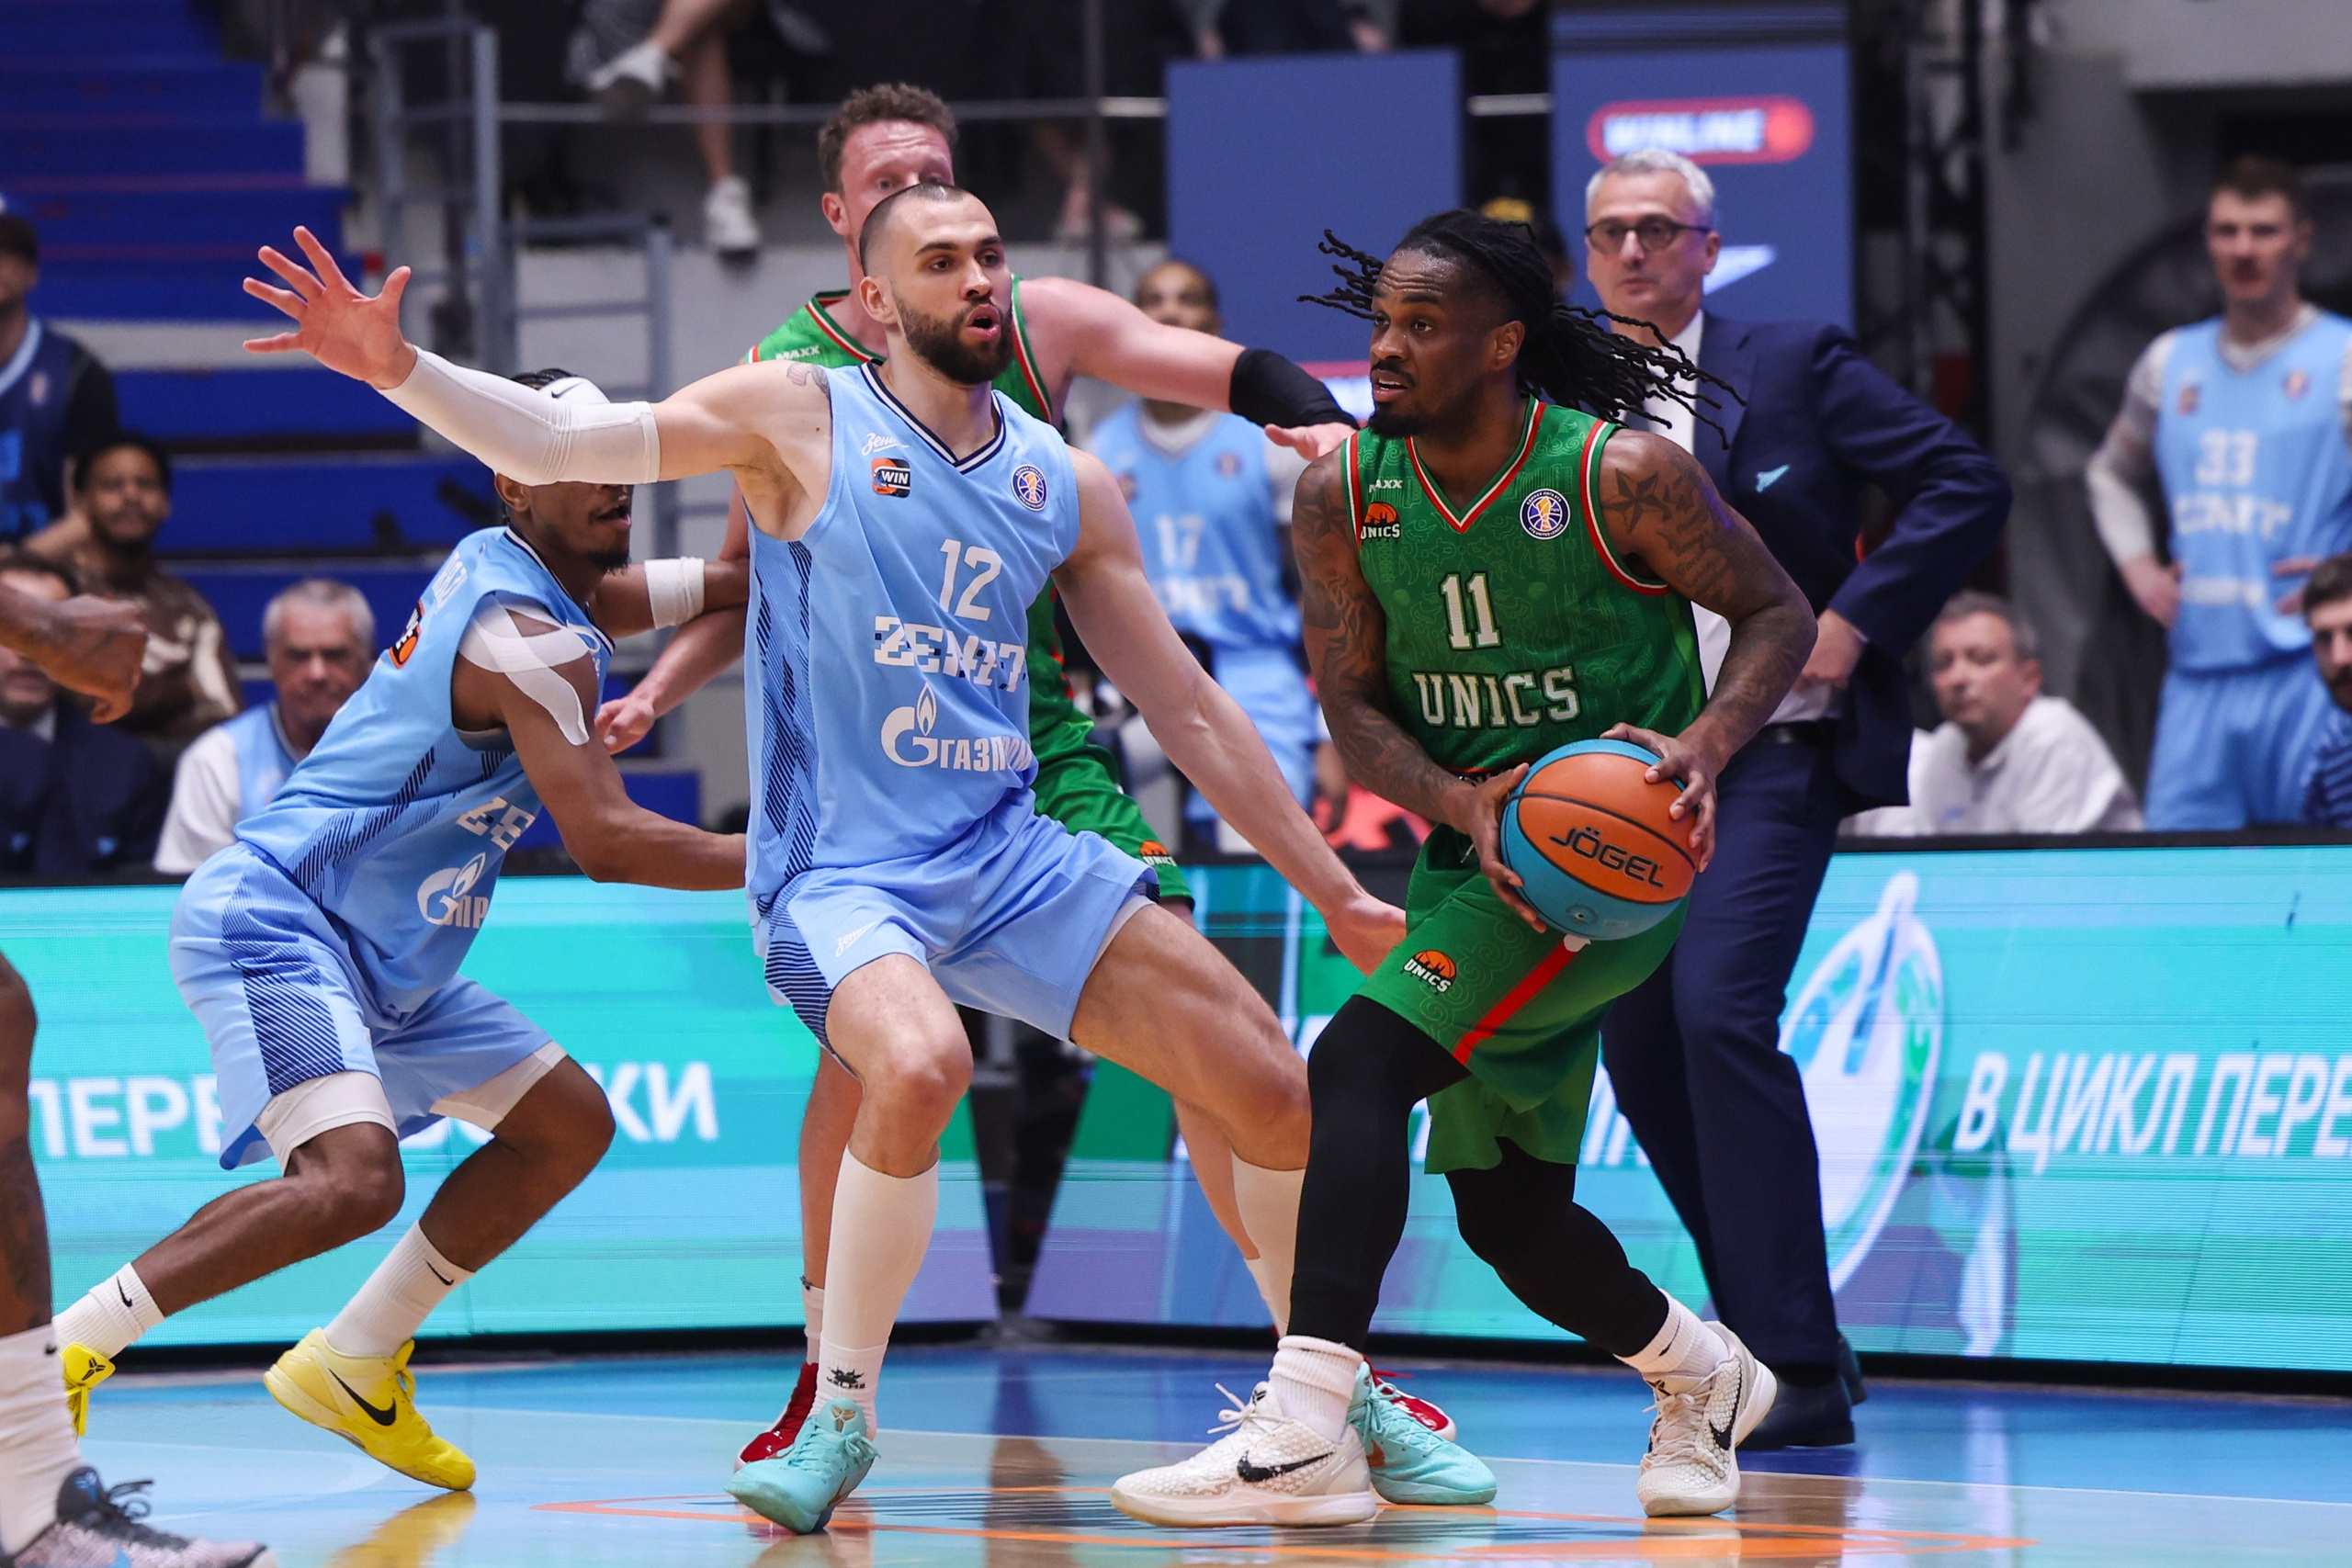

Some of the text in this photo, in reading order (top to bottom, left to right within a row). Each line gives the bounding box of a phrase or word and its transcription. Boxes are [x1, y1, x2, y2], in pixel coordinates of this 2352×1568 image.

[881, 470, 909, 484] WIN
[1360, 523, 1400, 540] UNICS
[939, 538, 1002, 621] 12
[1440, 572, 1501, 650] 11
[1412, 665, 1581, 728] UNICS
[1548, 825, 1664, 889] JÖGEL
[1404, 958, 1452, 992] UNICS
[1952, 1051, 2009, 1152] В
[2007, 1052, 2199, 1175] ЦИКЛ
